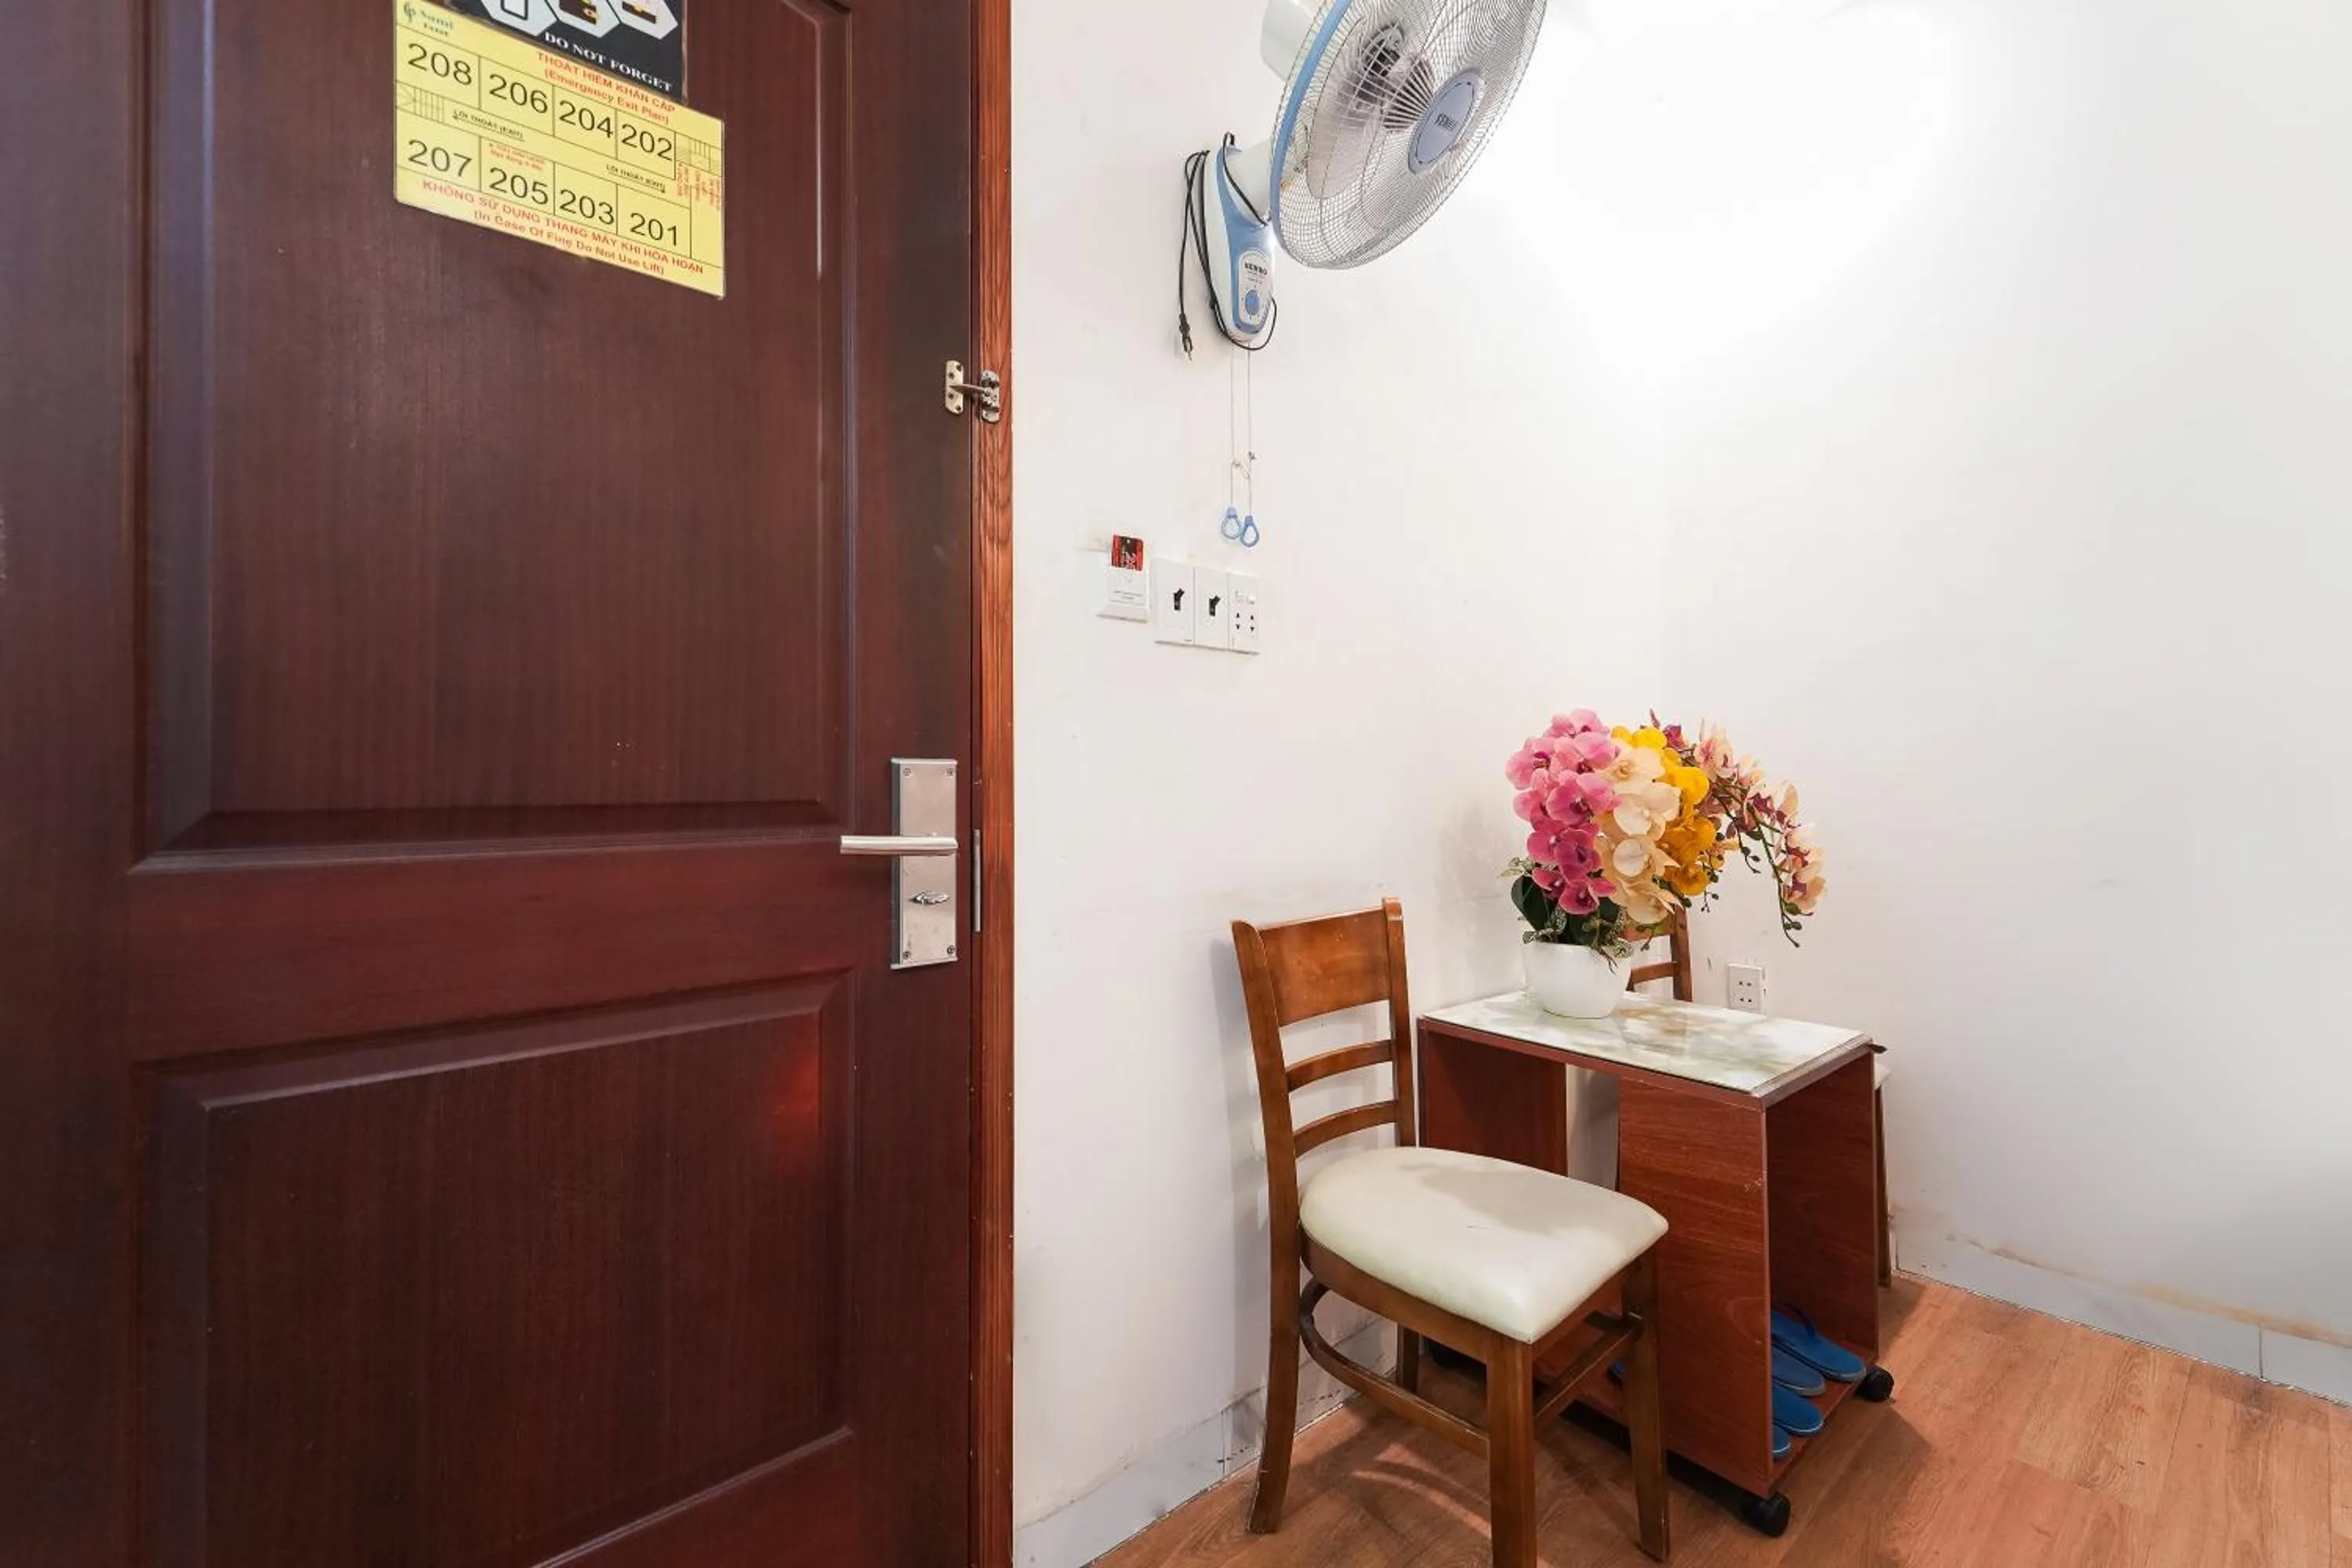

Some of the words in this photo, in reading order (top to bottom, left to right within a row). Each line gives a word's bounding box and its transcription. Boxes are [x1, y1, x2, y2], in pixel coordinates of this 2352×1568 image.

[407, 42, 473, 87] 208
[544, 31, 569, 49] DO
[573, 43, 607, 64] NOT
[610, 59, 673, 92] FORGET
[488, 73, 549, 115] 206
[618, 95, 639, 112] Exit
[559, 100, 614, 139] 204
[407, 139, 473, 178] 207
[621, 123, 673, 162] 202
[488, 166, 549, 206] 205
[558, 188, 615, 226] 203
[474, 209, 490, 222] (In
[495, 212, 526, 233] Case
[529, 227, 545, 238] Of
[576, 241, 592, 252] Do
[595, 247, 615, 261] Not
[619, 253, 641, 267] Use
[643, 261, 665, 276] Lift)
[546, 218, 588, 238] THANG
[620, 241, 641, 255] KHI
[630, 212, 678, 247] 201
